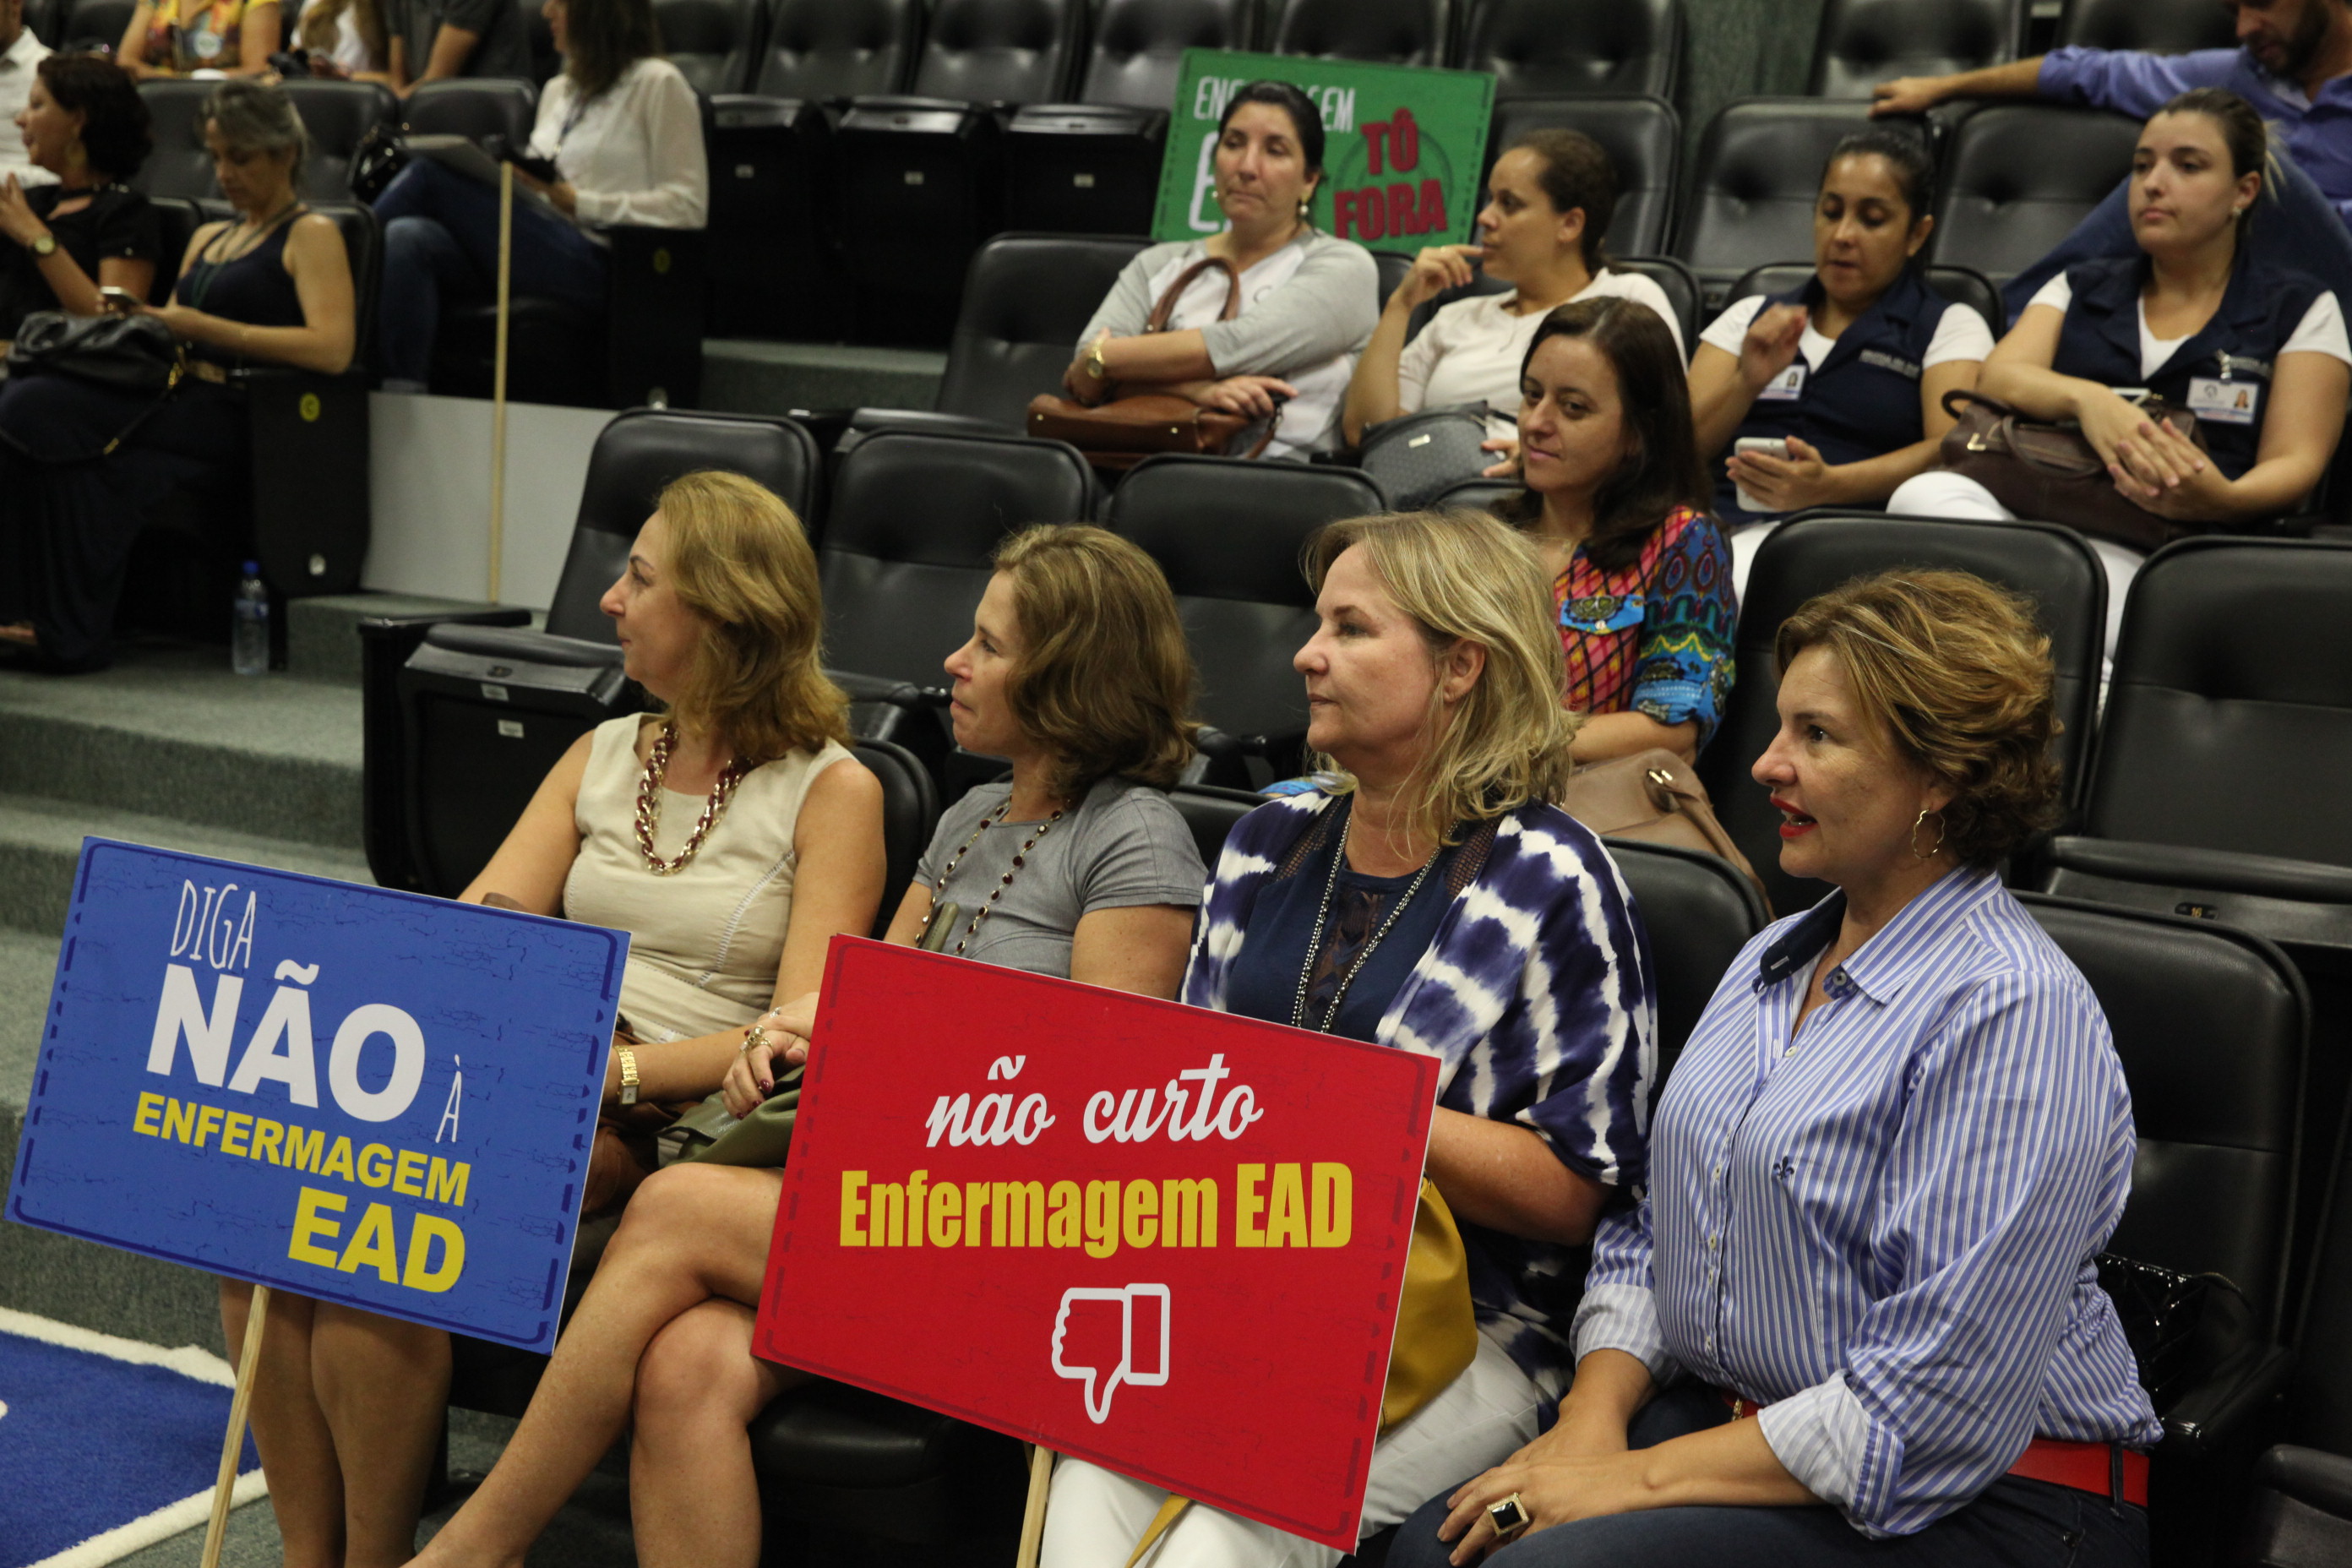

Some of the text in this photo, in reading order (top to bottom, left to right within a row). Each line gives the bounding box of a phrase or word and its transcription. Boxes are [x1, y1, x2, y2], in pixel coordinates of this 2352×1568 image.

[1360, 107, 1419, 175] TÔ
[1334, 178, 1448, 242] FORA
[170, 878, 257, 970] DIGA
[146, 959, 463, 1144] NÃO À
[926, 1053, 1264, 1147] não curto
[133, 1092, 471, 1206] ENFERMAGEM
[287, 1185, 466, 1293] EAD
[839, 1162, 1353, 1259] Enfermagem EAD
